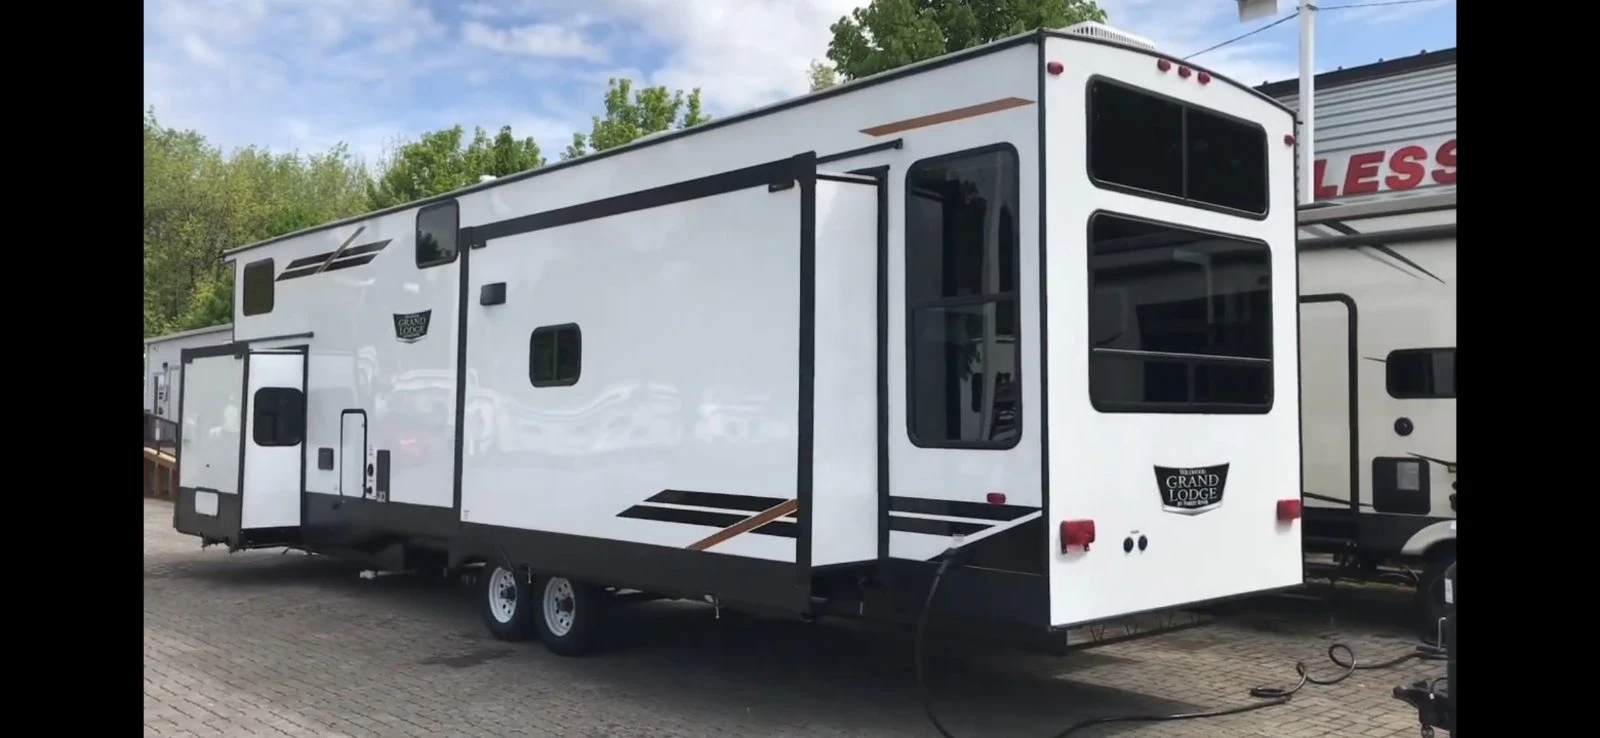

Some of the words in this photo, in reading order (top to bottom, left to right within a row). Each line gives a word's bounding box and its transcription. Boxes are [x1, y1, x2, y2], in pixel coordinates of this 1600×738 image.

[398, 317, 426, 327] GRAND
[1166, 474, 1219, 488] GRAND
[1169, 488, 1217, 501] LODGE
